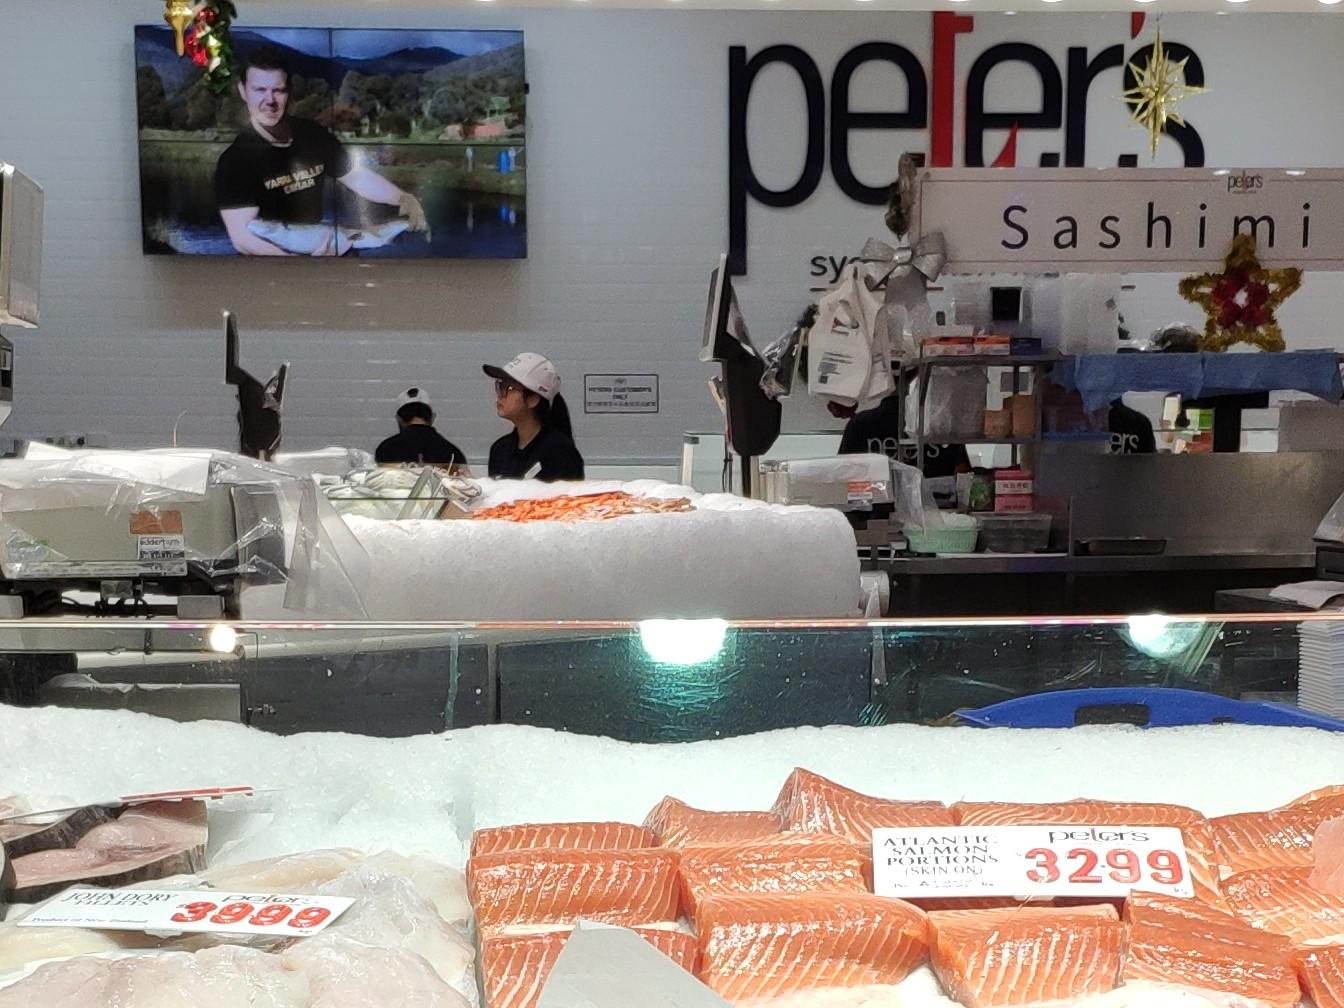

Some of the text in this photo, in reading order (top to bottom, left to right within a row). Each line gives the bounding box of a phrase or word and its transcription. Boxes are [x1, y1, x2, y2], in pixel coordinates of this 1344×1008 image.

[1001, 205, 1311, 250] Sashimi
[892, 845, 988, 856] SALMON
[887, 855, 999, 866] PORTIONS
